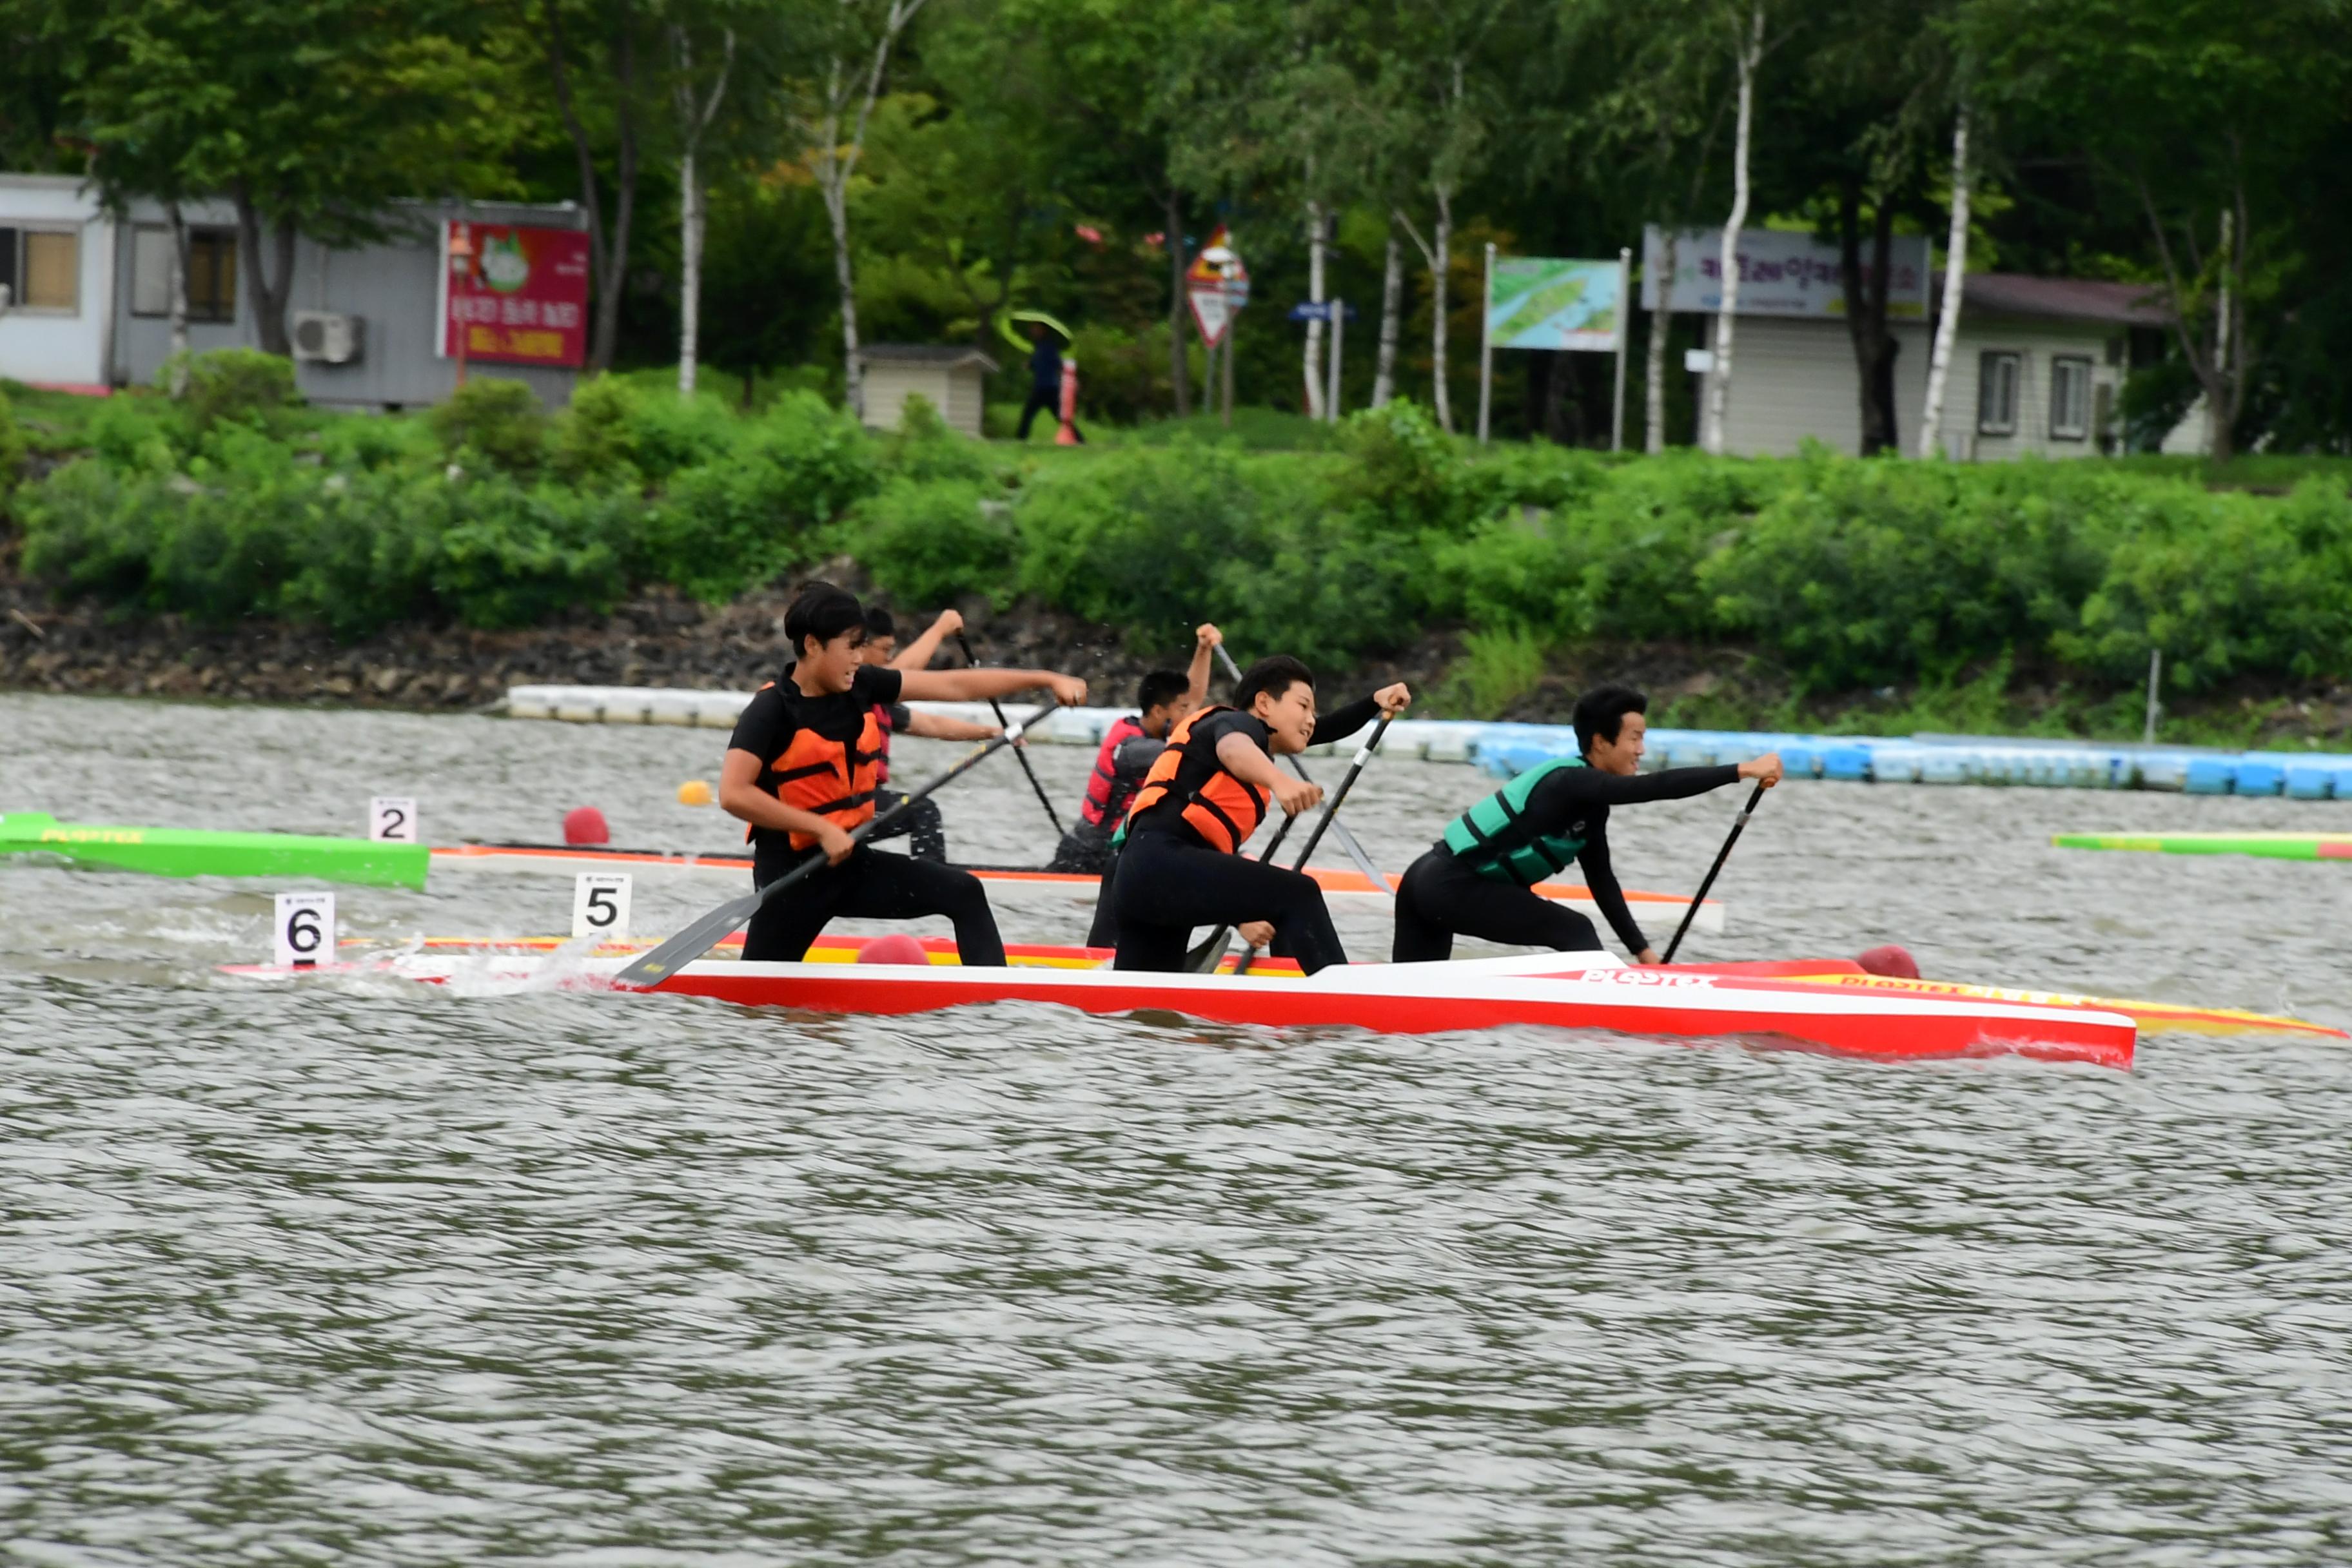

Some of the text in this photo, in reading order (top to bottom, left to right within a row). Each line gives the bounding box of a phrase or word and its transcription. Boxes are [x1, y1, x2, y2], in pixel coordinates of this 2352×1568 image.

[382, 808, 405, 838] 2
[585, 887, 618, 927] 5
[288, 908, 321, 952] 6
